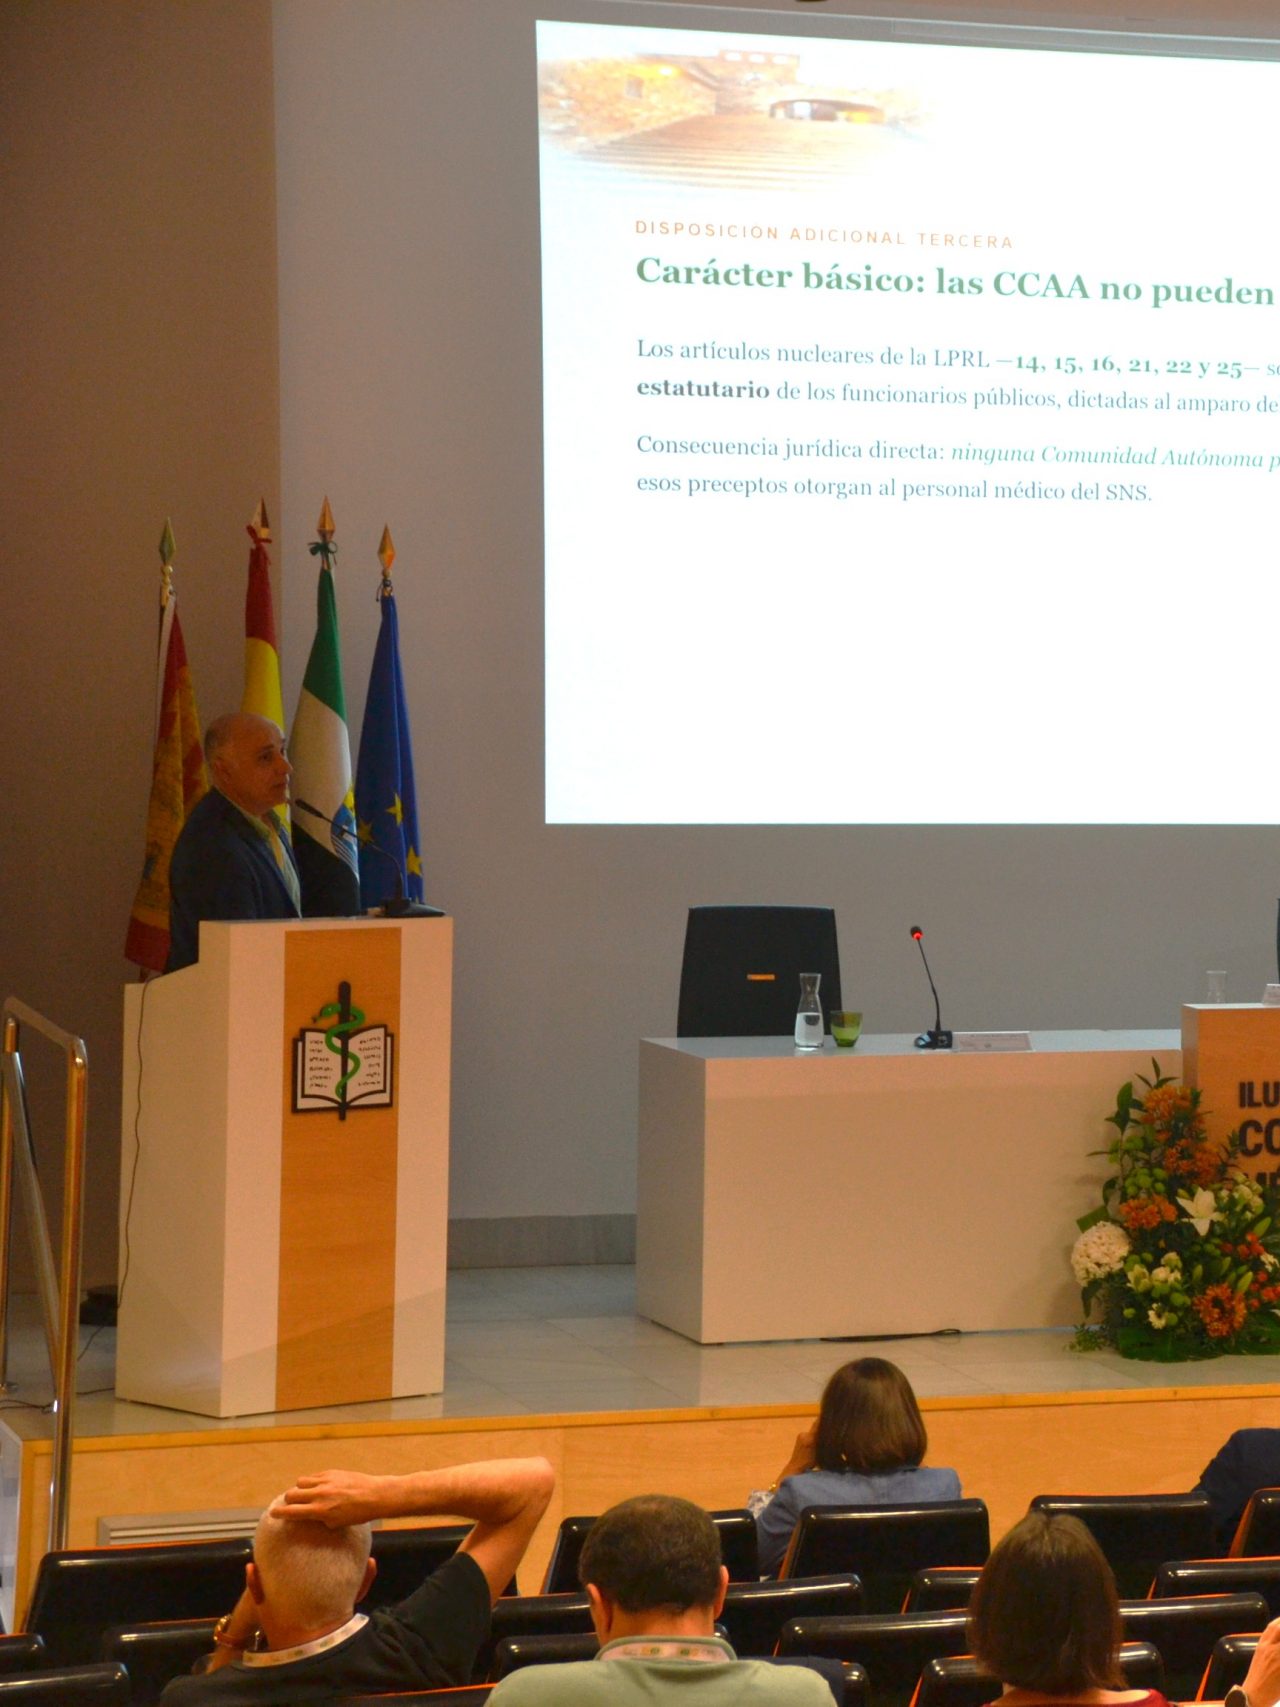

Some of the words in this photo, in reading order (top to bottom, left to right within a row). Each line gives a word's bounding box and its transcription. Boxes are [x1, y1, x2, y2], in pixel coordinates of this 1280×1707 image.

[790, 228, 905, 245] ADICIONAL
[918, 232, 1012, 249] TERCERA
[636, 256, 793, 288] Carácter
[802, 262, 924, 293] básico:
[936, 267, 983, 294] las
[993, 271, 1090, 299] CCAA
[1101, 282, 1142, 301] no
[1152, 277, 1274, 308] pueden
[637, 339, 674, 358] Los
[680, 341, 771, 361] artículos
[778, 344, 875, 364] nucleares
[881, 346, 904, 365] de
[911, 347, 927, 365] la
[935, 350, 990, 368] LPRL
[1055, 357, 1084, 375] 15,
[1092, 356, 1122, 375] 16,
[1128, 358, 1160, 377] 21,
[1166, 360, 1193, 375] 22
[1198, 362, 1211, 379] y
[637, 380, 770, 399] estatutario
[777, 381, 801, 400] de
[808, 382, 836, 400] los
[843, 384, 968, 404] funcionarios
[974, 387, 1061, 410] públicos,
[1067, 389, 1149, 409] dictadas
[1154, 391, 1171, 410] al
[1177, 397, 1251, 417] amparo
[636, 435, 779, 456] Consecuencia
[782, 438, 863, 462] jurídica
[869, 439, 944, 460] directa:
[952, 443, 1034, 465] ninguna
[1041, 446, 1158, 465] Comunidad
[1161, 448, 1264, 468] Autónoma
[637, 477, 682, 492] esos
[688, 477, 788, 498] preceptos
[794, 478, 872, 500] otorgan
[879, 478, 896, 497] al
[902, 479, 988, 501] personal
[994, 481, 1066, 500] médico
[1072, 482, 1100, 501] del
[1106, 484, 1152, 502] SNS.
